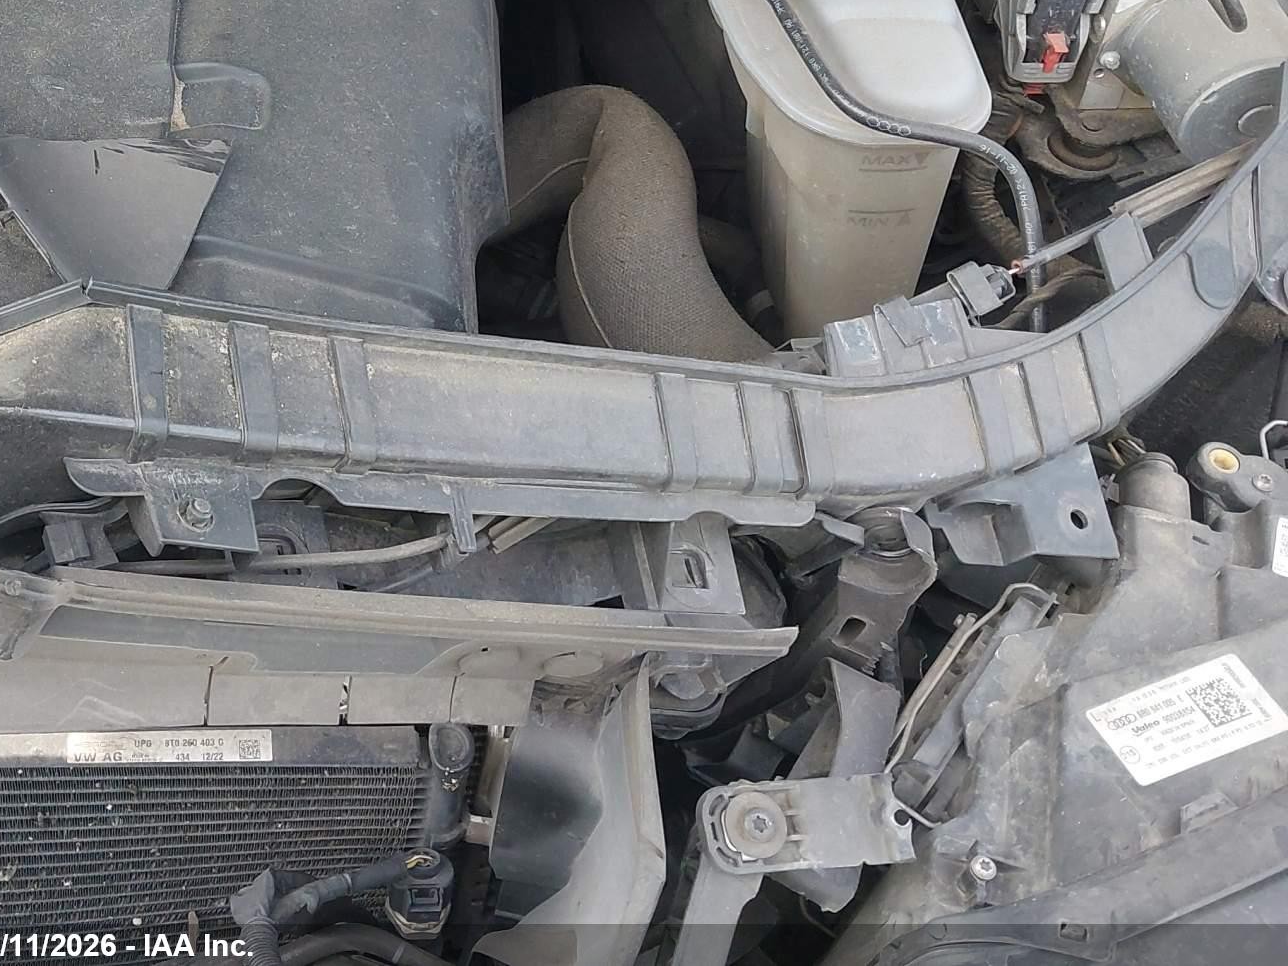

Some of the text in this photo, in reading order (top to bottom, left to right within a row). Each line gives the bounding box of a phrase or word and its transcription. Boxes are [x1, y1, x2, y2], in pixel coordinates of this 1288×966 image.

[862, 154, 912, 165] MAX
[847, 216, 889, 227] MIN
[1130, 719, 1161, 735] Valeo
[200, 737, 215, 747] 403
[73, 753, 97, 762] VW
[103, 751, 123, 762] AG
[201, 753, 224, 761] 12/22
